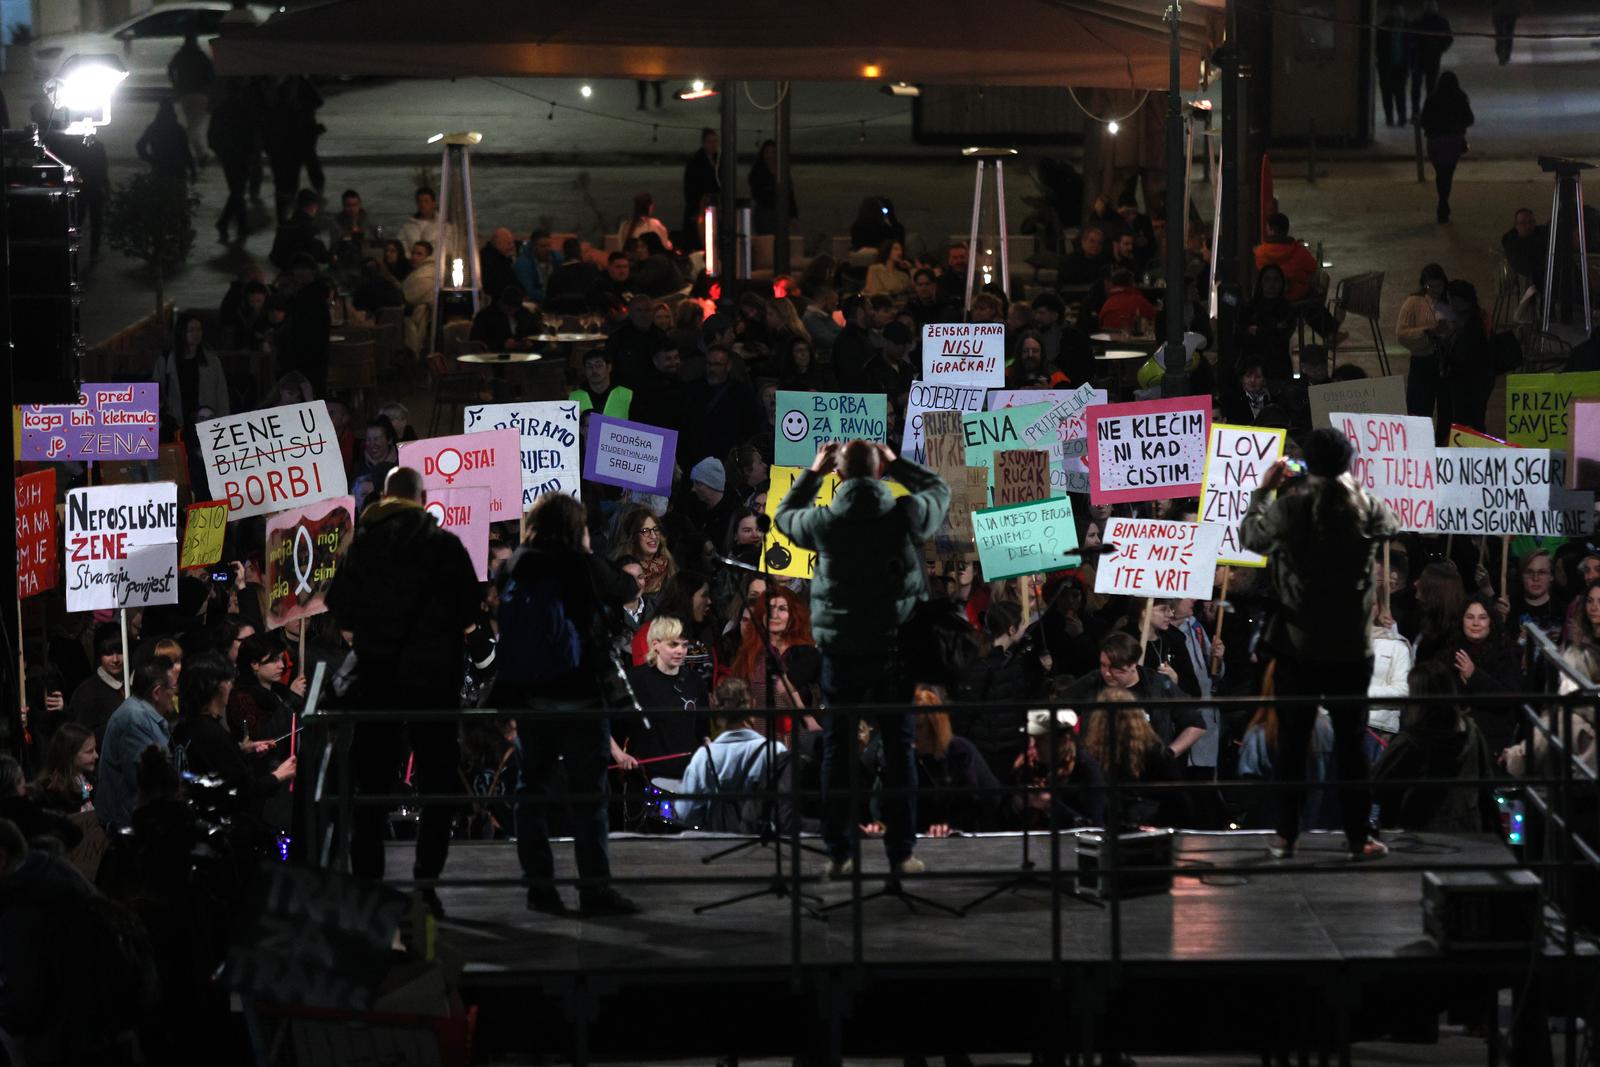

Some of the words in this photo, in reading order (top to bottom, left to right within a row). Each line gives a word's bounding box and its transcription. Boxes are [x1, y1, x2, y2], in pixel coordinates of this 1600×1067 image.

[928, 325, 970, 337] ŽENSKA
[974, 326, 1003, 336] PRAVA
[942, 339, 984, 355] NISU
[97, 385, 133, 411] pred
[812, 395, 868, 415] BORBA
[911, 386, 983, 411] ODJEBITE
[1511, 391, 1573, 411] PRIZIV
[24, 412, 62, 431] koga
[71, 412, 94, 425] bih
[103, 411, 157, 425] kleknula
[209, 423, 284, 451] ŽENE
[298, 408, 316, 433] U
[812, 417, 832, 432] ZA
[962, 414, 1018, 448] ENA
[1098, 420, 1121, 441] NE
[1132, 413, 1202, 438] KLEČIM
[1508, 414, 1569, 443] SAVJES
[47, 437, 65, 457] je
[610, 432, 652, 450] PODRŠKA
[1216, 430, 1276, 460] LOV
[1367, 420, 1407, 452] SAM
[213, 433, 325, 476] BIZNISU
[600, 444, 659, 463] STUDENTKINJAMA
[1114, 442, 1131, 463] NI
[1141, 440, 1180, 460] KAD
[609, 457, 646, 474] SRBIJE!
[1003, 464, 1045, 486] RUČAK
[1127, 464, 1189, 486] ČISTIM
[1224, 460, 1258, 487] NA
[1382, 457, 1434, 490] TIJELA
[1459, 457, 1507, 486] NISAM
[224, 462, 322, 511] BORBI
[1203, 484, 1253, 522] ŽENS
[1482, 487, 1529, 511] DOMA
[33, 510, 50, 534] NA
[1043, 525, 1055, 538] O
[1112, 522, 1199, 541] BINARNOST
[1436, 508, 1468, 531] ISAM
[1471, 509, 1538, 534] SIGURNA
[1542, 510, 1586, 534] NIGDJE
[33, 539, 48, 564] JE
[71, 533, 128, 563] ŽENE
[318, 528, 339, 553] moj
[1120, 543, 1139, 560] JE
[1148, 544, 1179, 561] MIT
[70, 564, 130, 599] Stvaraju
[119, 566, 175, 605] povijest
[1155, 568, 1191, 591] VRIT
